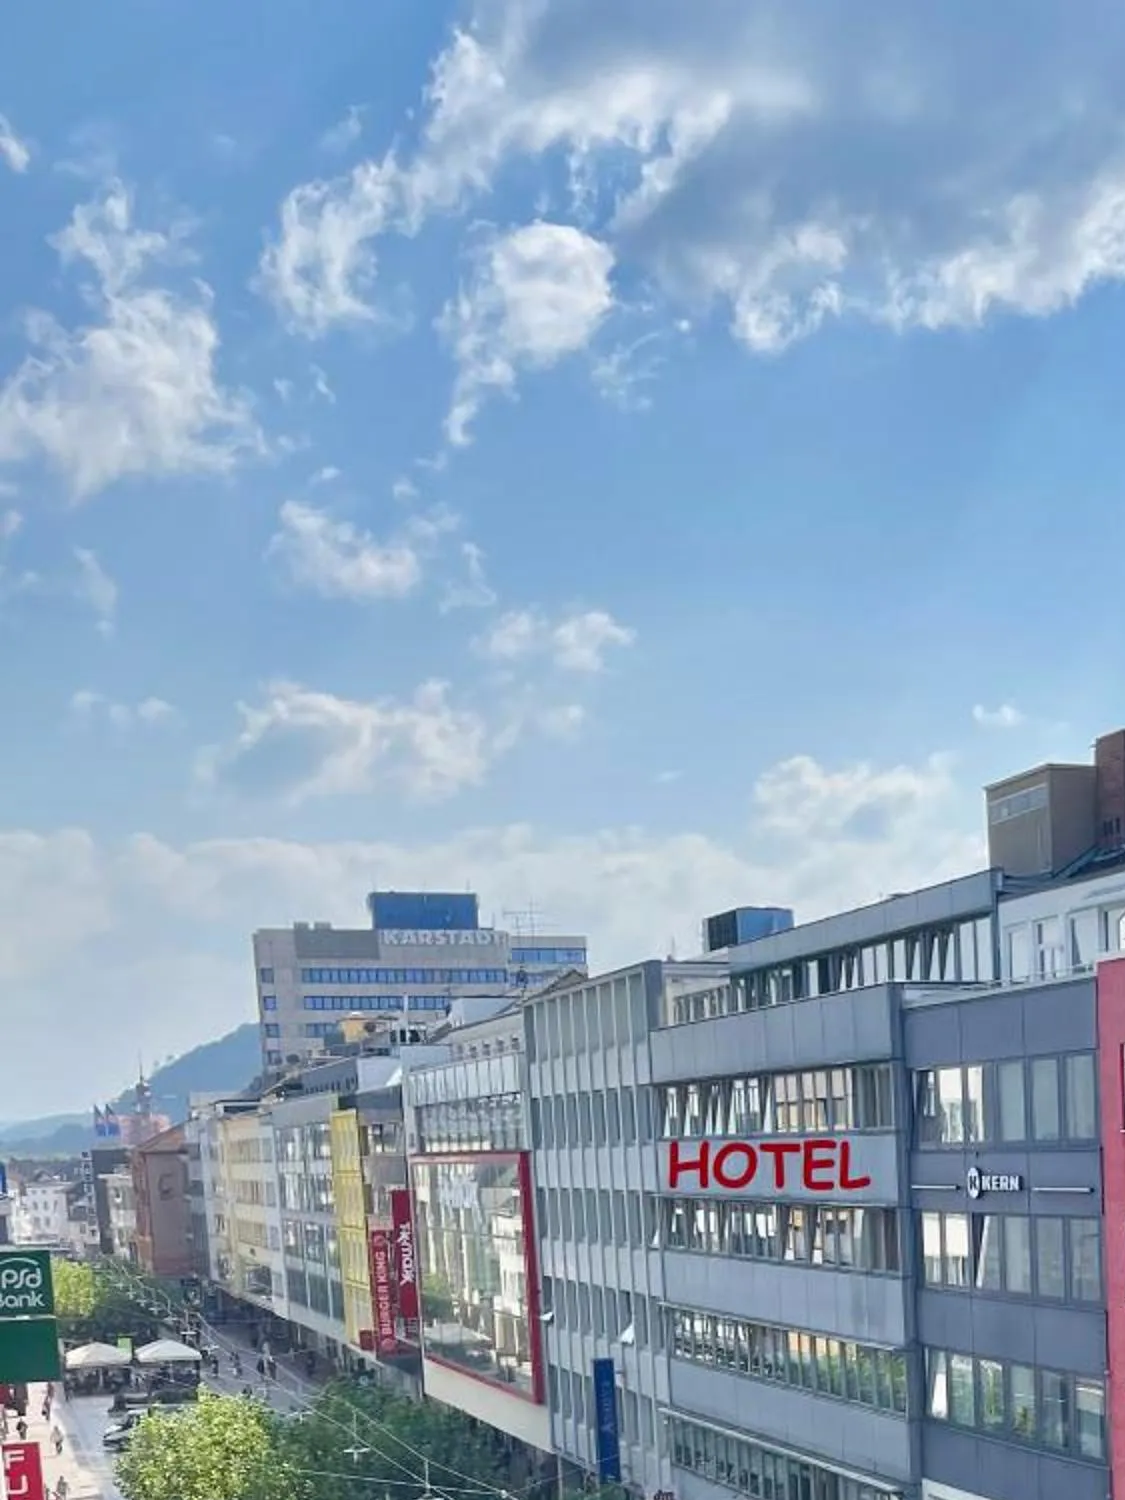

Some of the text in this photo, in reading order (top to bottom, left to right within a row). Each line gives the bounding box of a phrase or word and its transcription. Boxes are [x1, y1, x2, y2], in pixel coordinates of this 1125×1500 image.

[383, 929, 505, 946] KARSTADT
[667, 1139, 871, 1190] HOTEL
[981, 1175, 1019, 1191] KERN
[0, 1290, 46, 1307] ank
